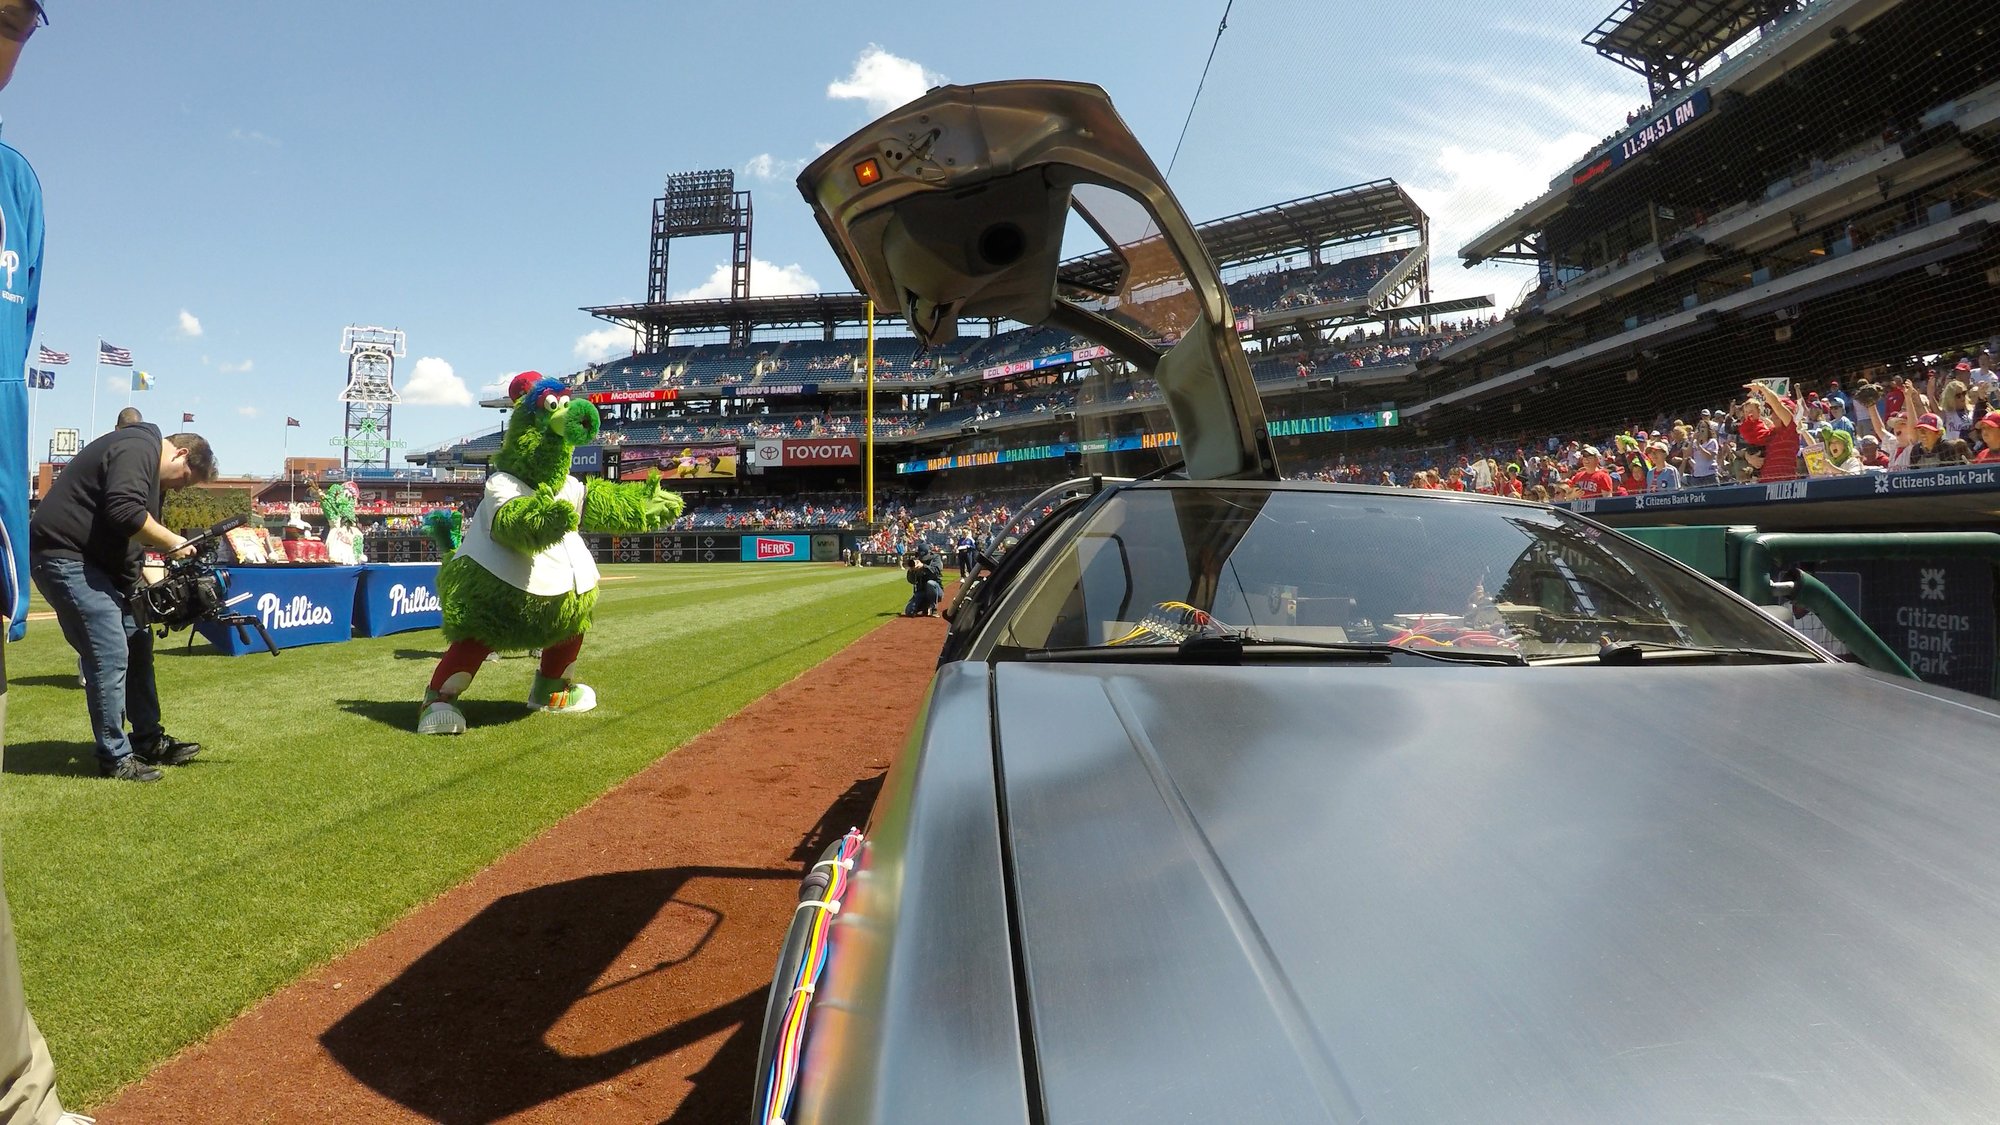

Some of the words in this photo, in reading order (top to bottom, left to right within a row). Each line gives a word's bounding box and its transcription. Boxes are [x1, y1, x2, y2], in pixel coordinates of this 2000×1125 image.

[1622, 114, 1673, 159] 11:34:51
[1675, 100, 1695, 126] AM
[611, 390, 655, 400] McDonald's
[771, 385, 803, 394] BAKERY
[1142, 431, 1179, 449] HAPPY
[573, 452, 597, 465] and
[787, 445, 853, 459] TOYOTA
[927, 456, 952, 471] HAPPY
[957, 451, 1000, 468] BIRTHDAY
[1006, 445, 1051, 462] PHANATIC
[1892, 475, 1936, 489] Citizens
[1937, 471, 1966, 486] Bank
[1968, 469, 1994, 484] Park
[1645, 496, 1671, 506] Citizens
[1672, 494, 1689, 504] Bank
[1690, 492, 1706, 503] Park
[1766, 482, 1808, 500] PHILLIES.COM
[760, 543, 791, 554] HERR'S
[389, 583, 442, 617] Phillie
[257, 592, 332, 630] Phillies
[1896, 606, 1969, 631] Citizens
[1908, 629, 1953, 653] Bank
[1910, 651, 1949, 675] Park
